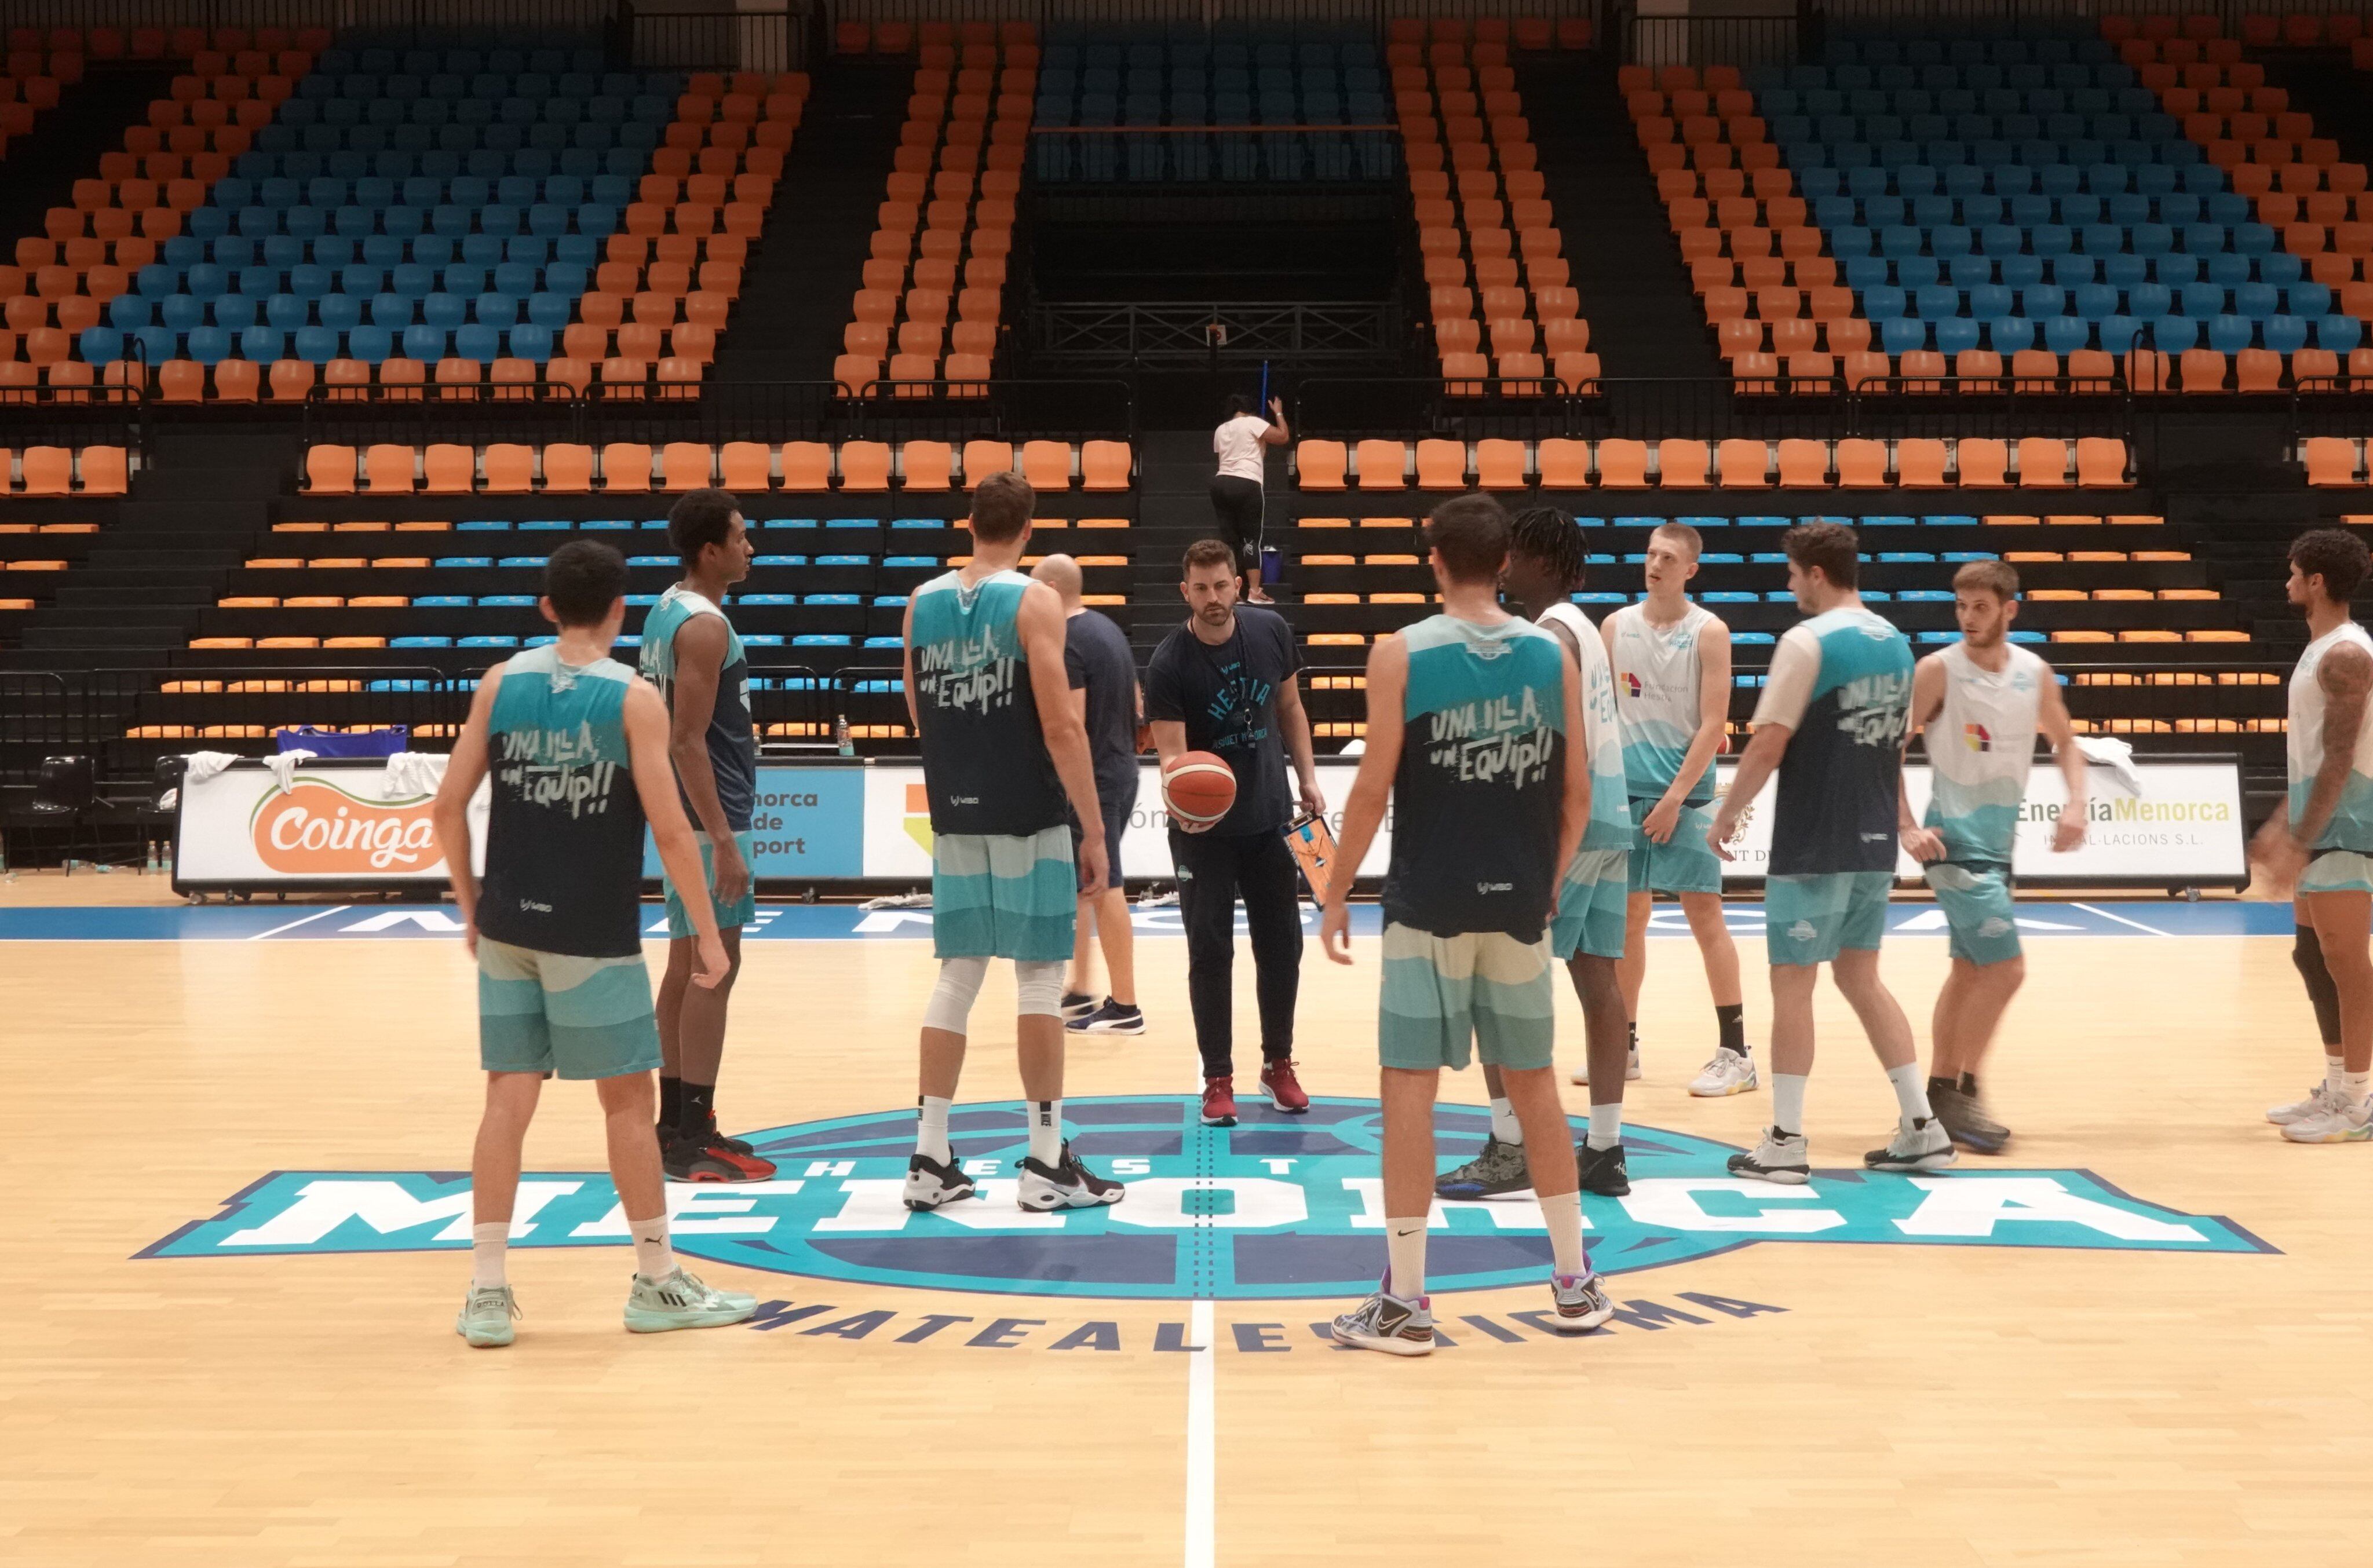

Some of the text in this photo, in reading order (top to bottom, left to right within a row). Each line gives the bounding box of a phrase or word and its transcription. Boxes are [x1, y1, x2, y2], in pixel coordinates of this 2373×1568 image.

[1432, 703, 1477, 741] UNA
[755, 794, 817, 807] norca
[2016, 798, 2229, 823] EneíaMenorca
[753, 812, 783, 830] de
[271, 806, 433, 868] Coinga
[753, 838, 805, 858] port
[2175, 834, 2203, 845] S.L.
[217, 1178, 2209, 1246] MENORCA
